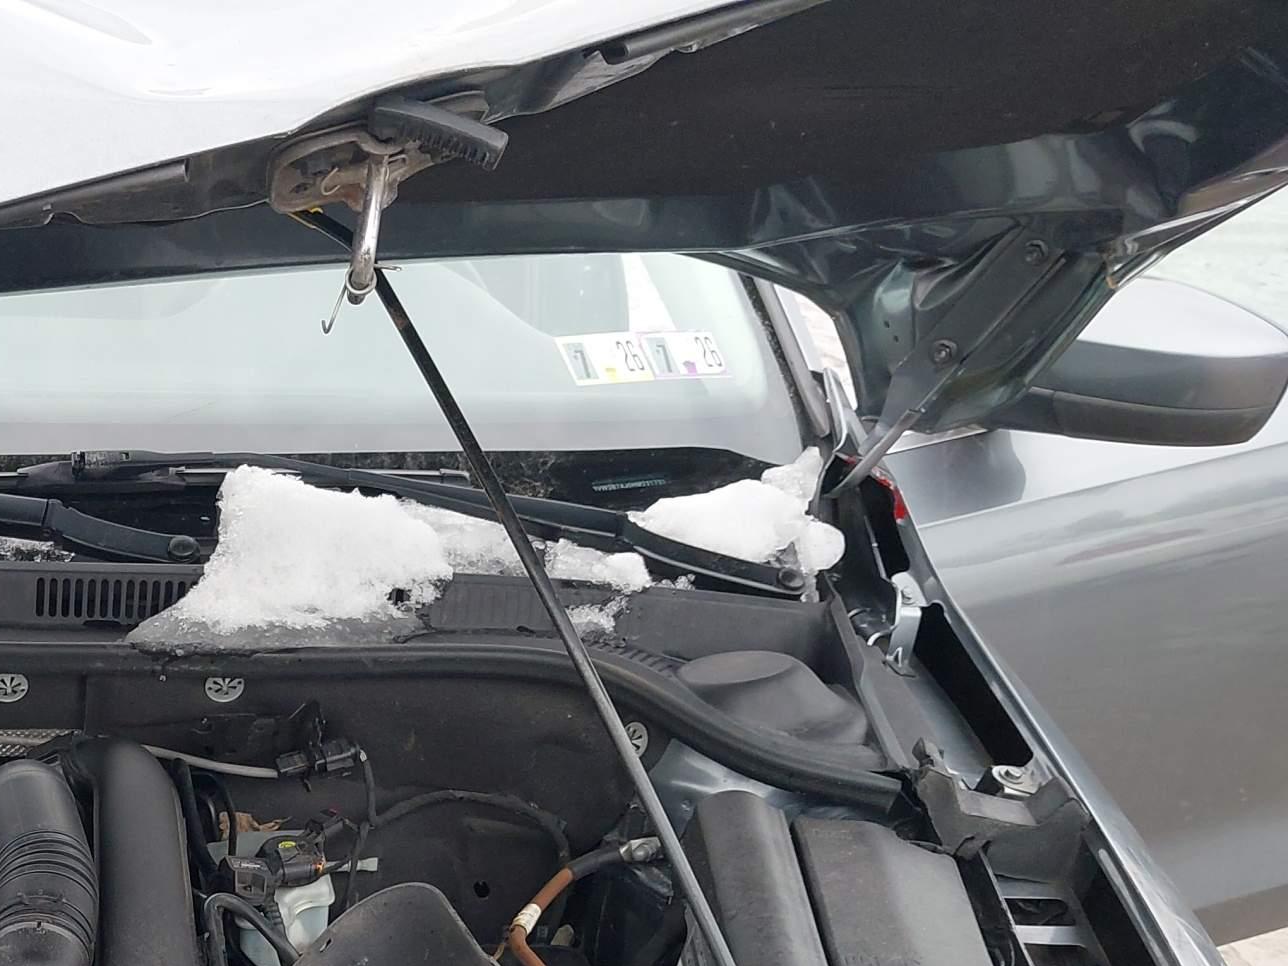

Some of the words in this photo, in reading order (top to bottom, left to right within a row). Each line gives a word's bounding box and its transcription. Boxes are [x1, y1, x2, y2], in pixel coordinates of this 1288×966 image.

[574, 350, 591, 379] 7
[615, 340, 645, 372] 26
[655, 344, 673, 373] 7
[694, 336, 723, 367] 26
